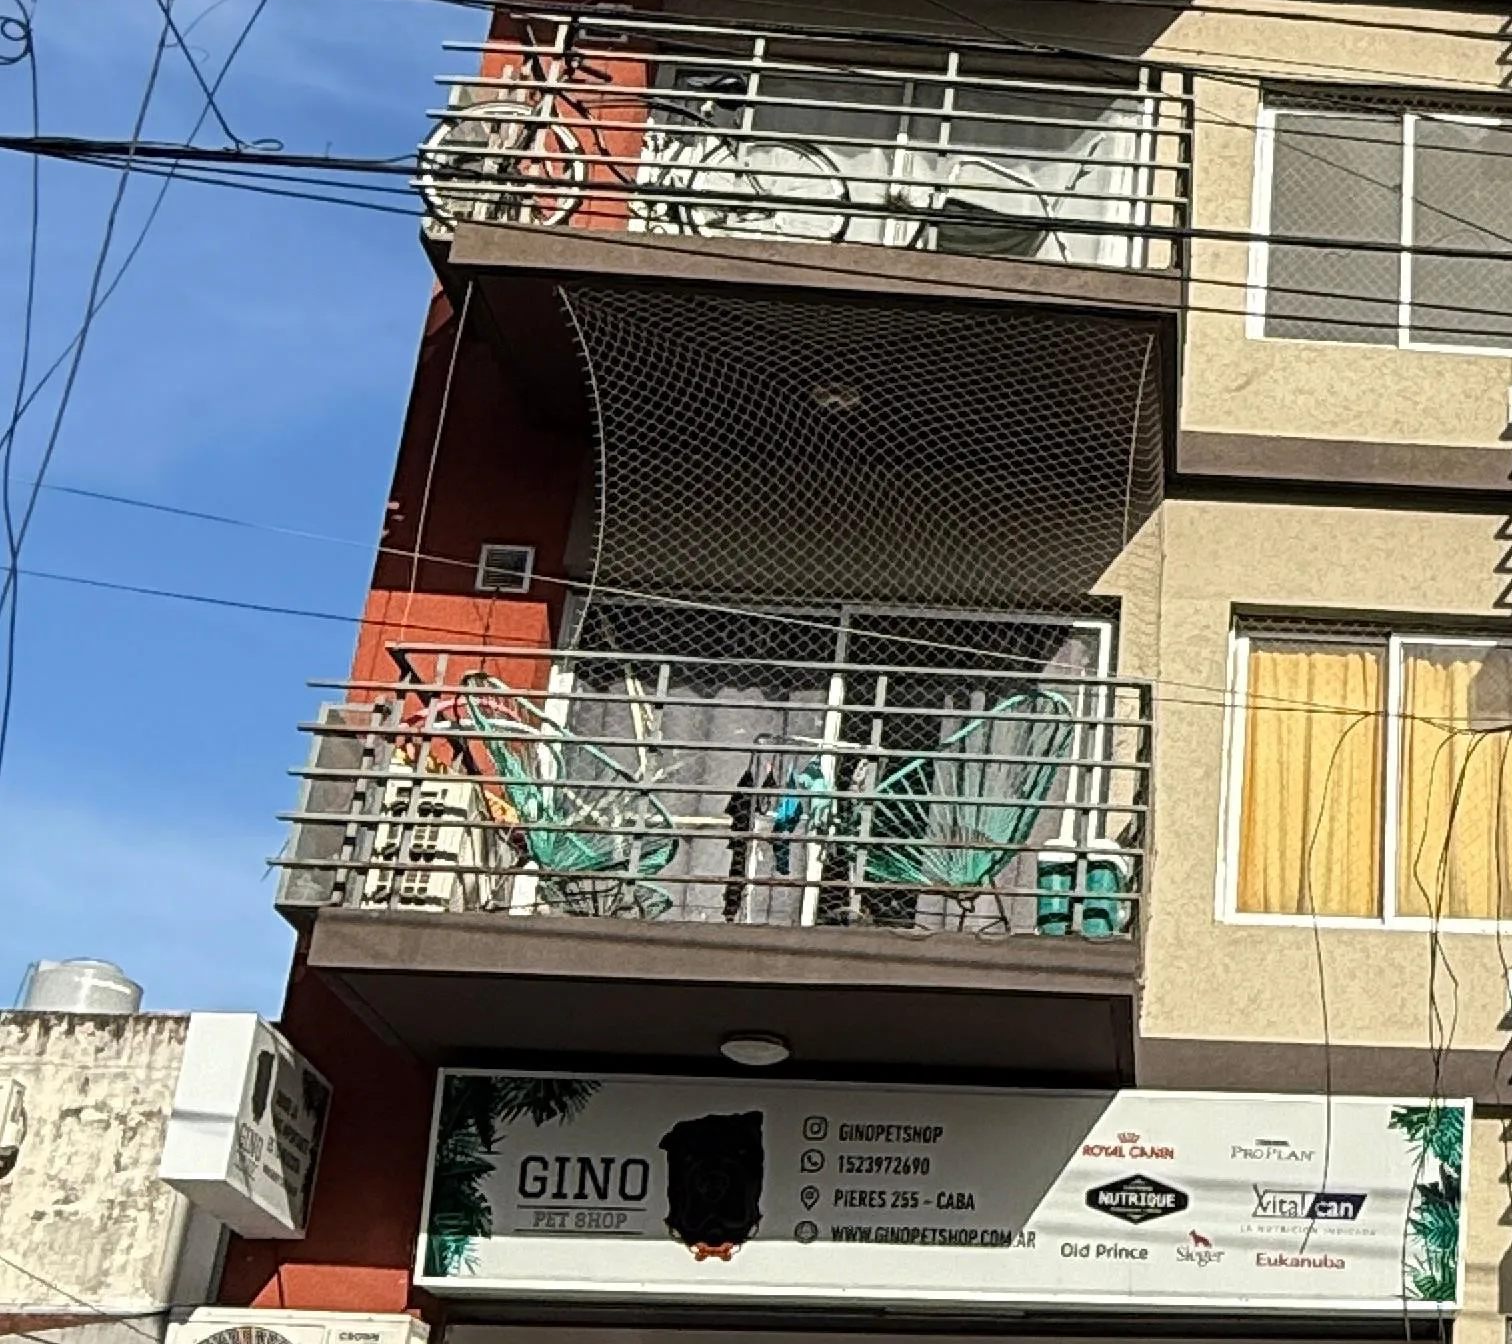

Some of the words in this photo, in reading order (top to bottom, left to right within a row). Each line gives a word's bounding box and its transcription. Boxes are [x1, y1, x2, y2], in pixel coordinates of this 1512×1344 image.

[839, 1123, 944, 1144] GINOPETSHOP
[1082, 1144, 1126, 1158] ROYAL
[1129, 1146, 1174, 1160] CANIN
[838, 1155, 931, 1175] 1523972690
[518, 1155, 650, 1201] GINO
[833, 1188, 886, 1208] PIERES
[890, 1190, 920, 1209] 255
[936, 1191, 976, 1211] CABA
[1098, 1190, 1176, 1208] NUTRIQUE
[532, 1211, 570, 1228] PET
[574, 1212, 628, 1229] SHOP
[831, 1225, 1037, 1249] WWW.GINOPETSHOP.COM.AR
[1060, 1242, 1091, 1258] Old
[1095, 1243, 1149, 1260] Prince
[1256, 1253, 1346, 1270] Eukanuba
